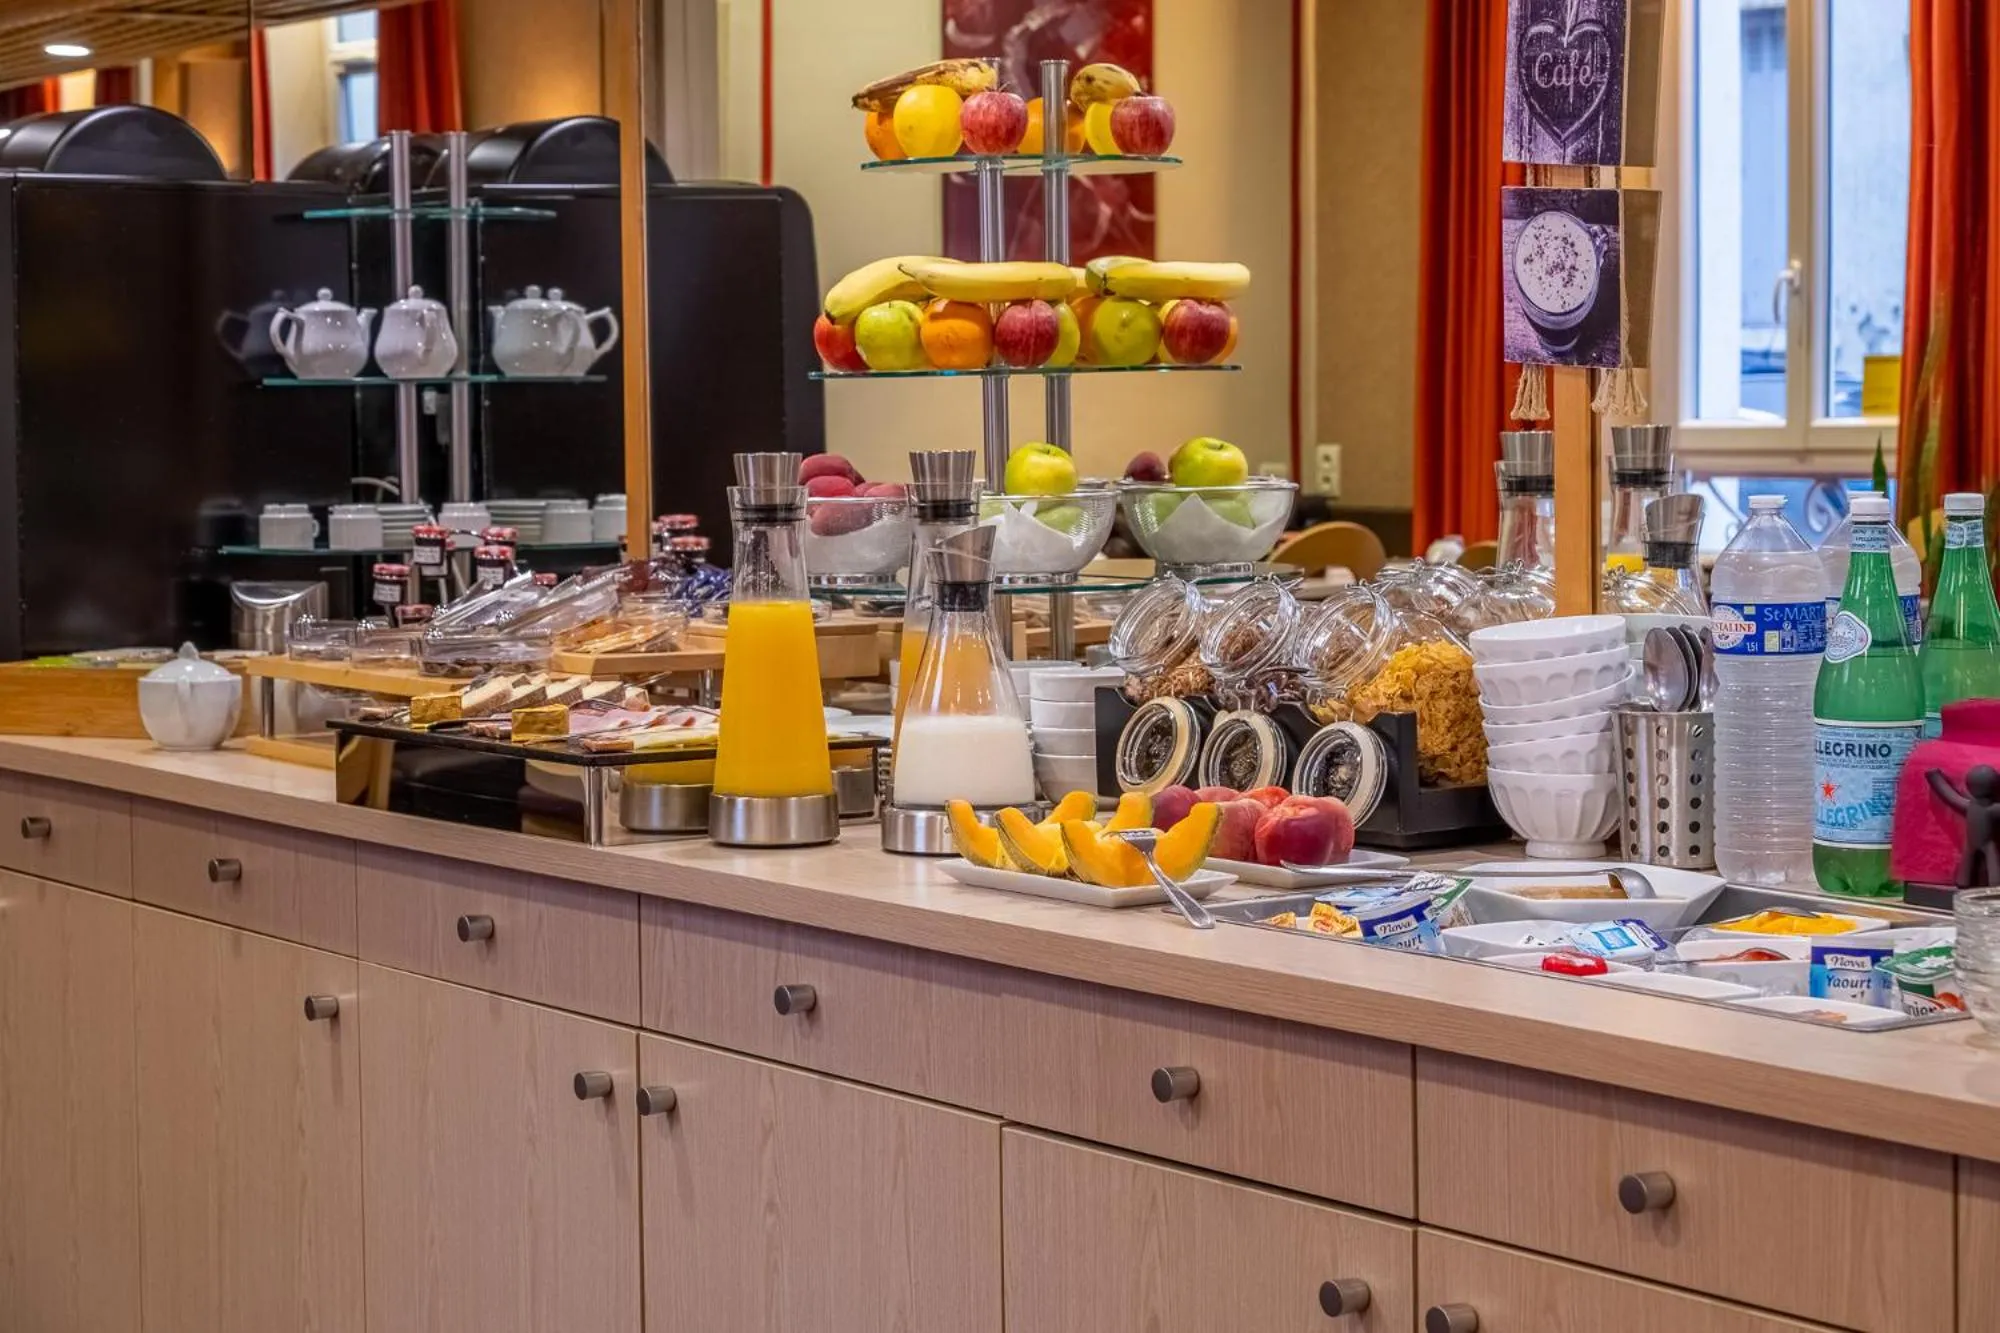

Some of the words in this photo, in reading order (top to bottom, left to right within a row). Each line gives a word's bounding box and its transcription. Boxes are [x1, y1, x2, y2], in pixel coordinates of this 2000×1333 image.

[1535, 50, 1594, 106] Café
[1713, 622, 1755, 633] STALINE
[1396, 933, 1422, 949] ourt
[1826, 973, 1872, 990] Yaourt
